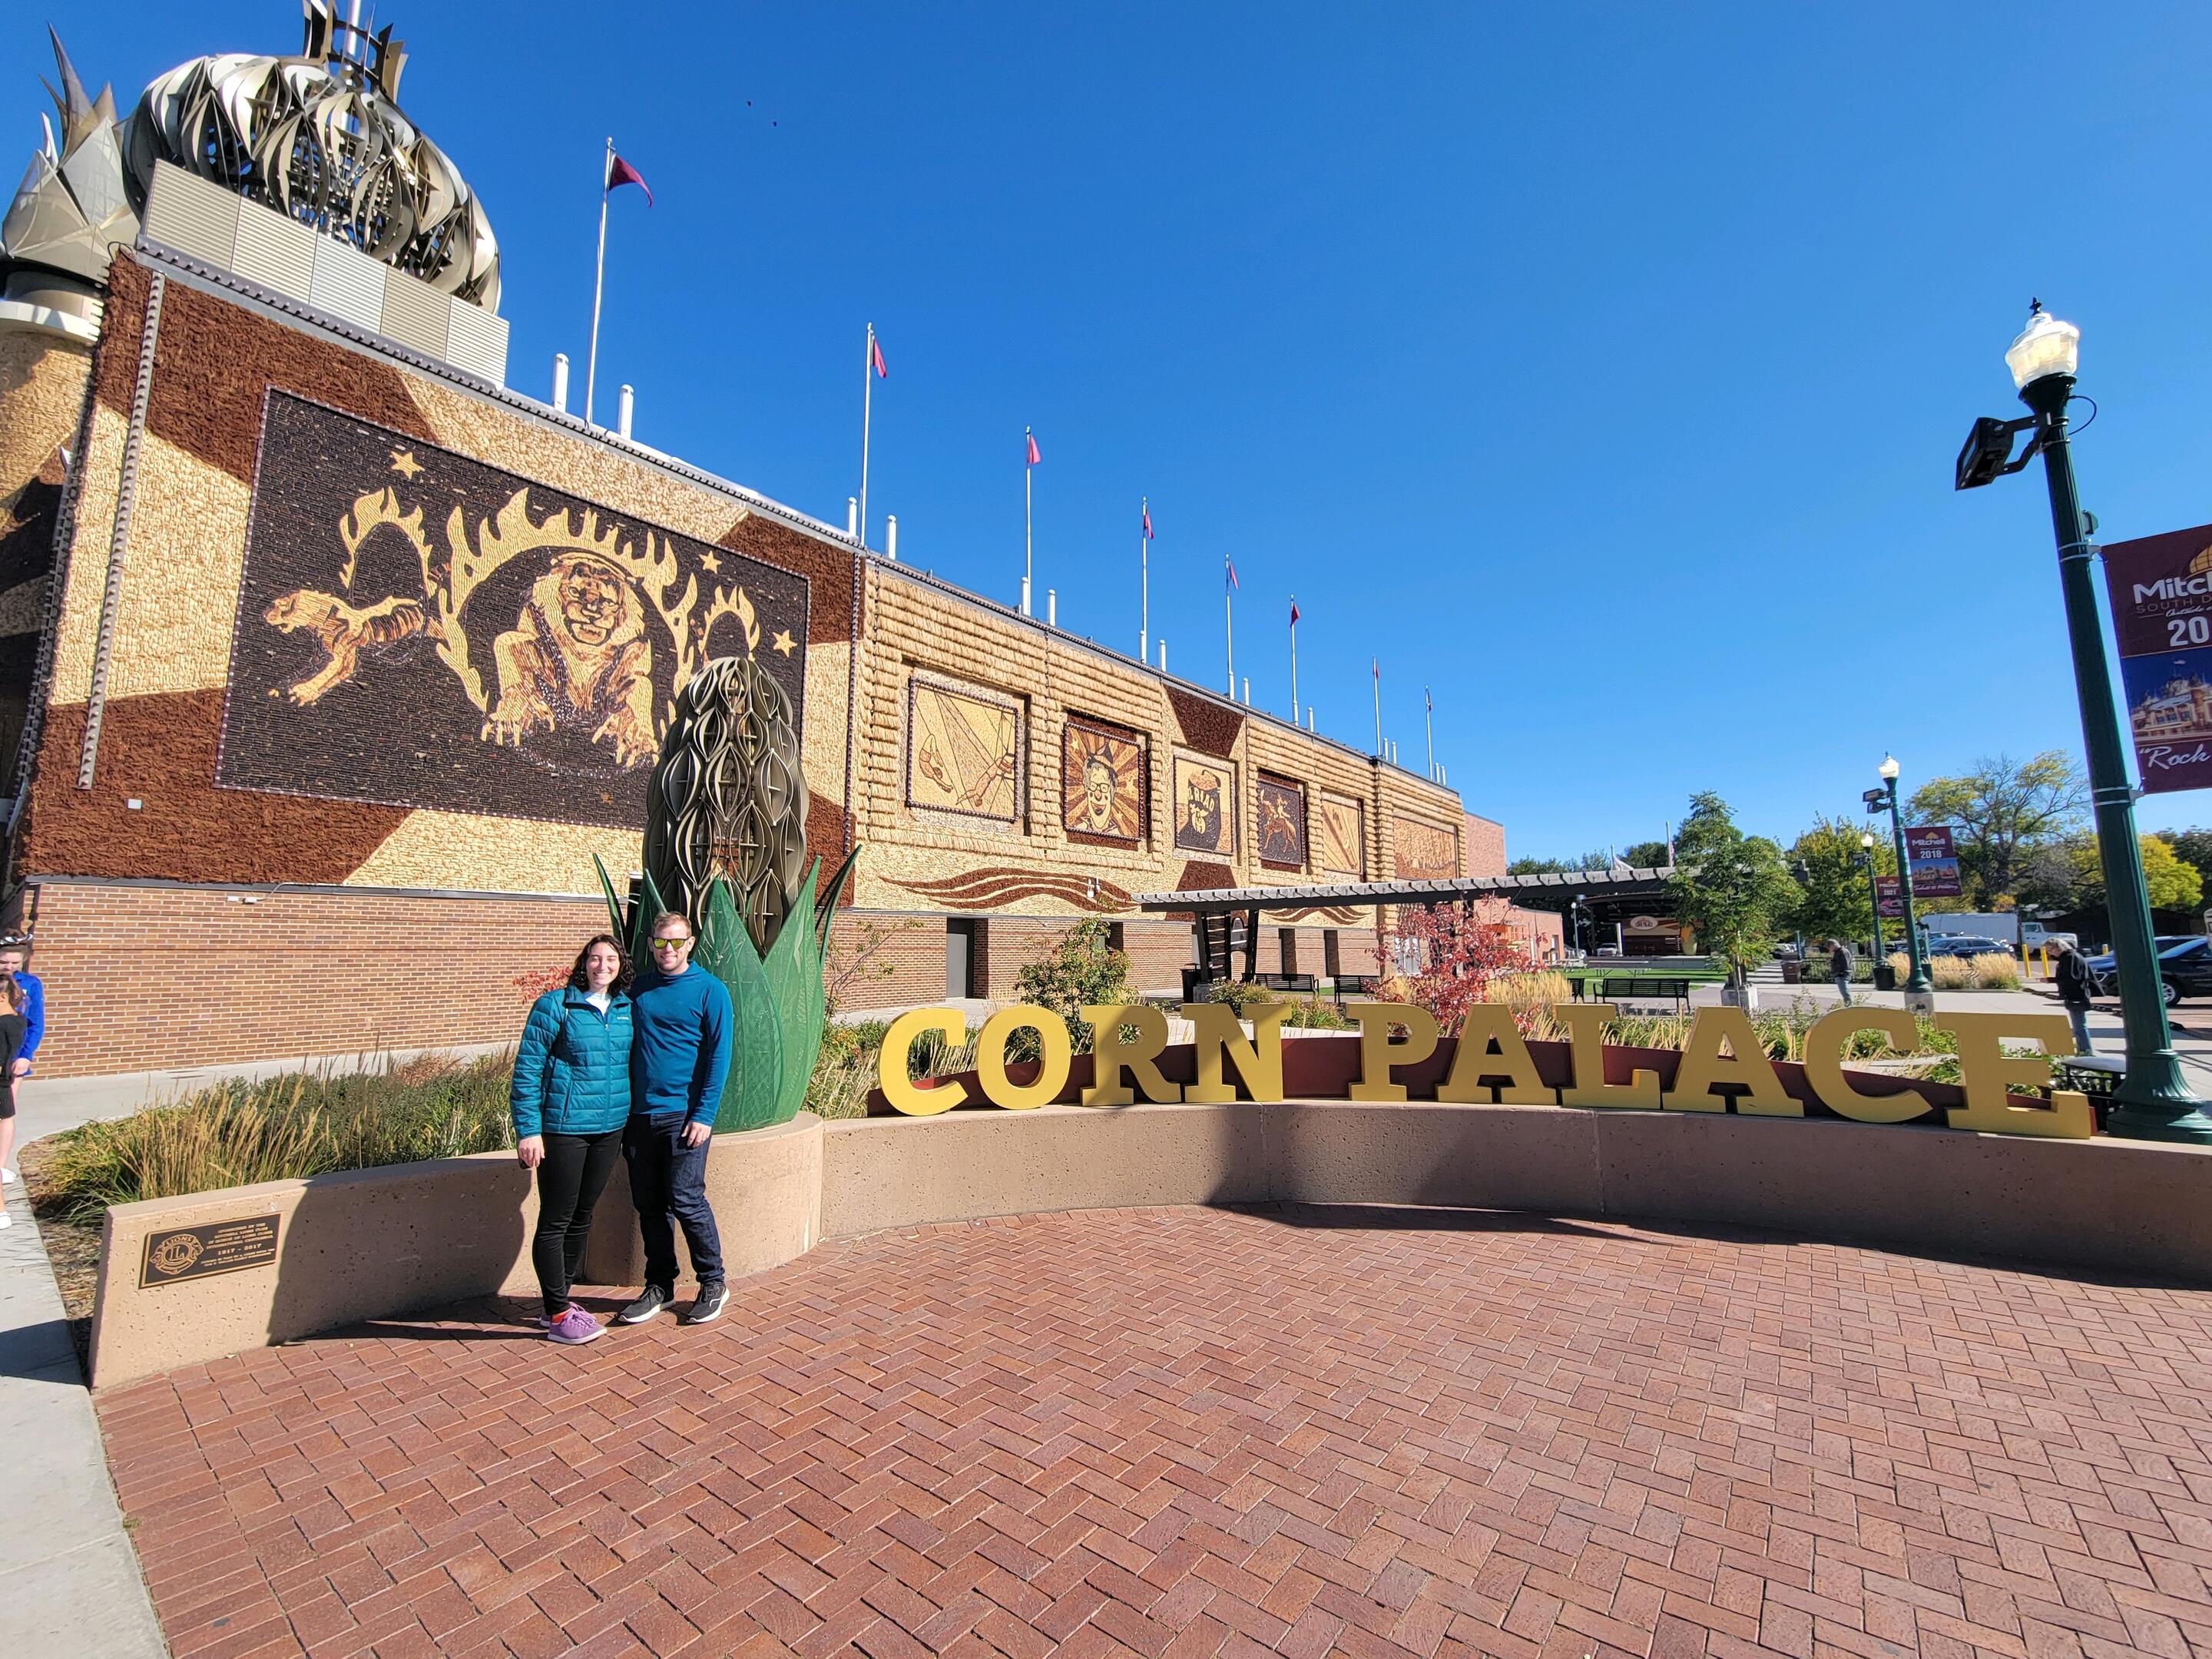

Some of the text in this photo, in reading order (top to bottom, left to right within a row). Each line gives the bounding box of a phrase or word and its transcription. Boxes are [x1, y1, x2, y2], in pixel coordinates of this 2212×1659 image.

[2136, 598, 2193, 614] SOUTH
[1912, 838, 1945, 846] Mitchell
[1920, 849, 1942, 859] 2018
[875, 1000, 2092, 1140] CORN PALACE
